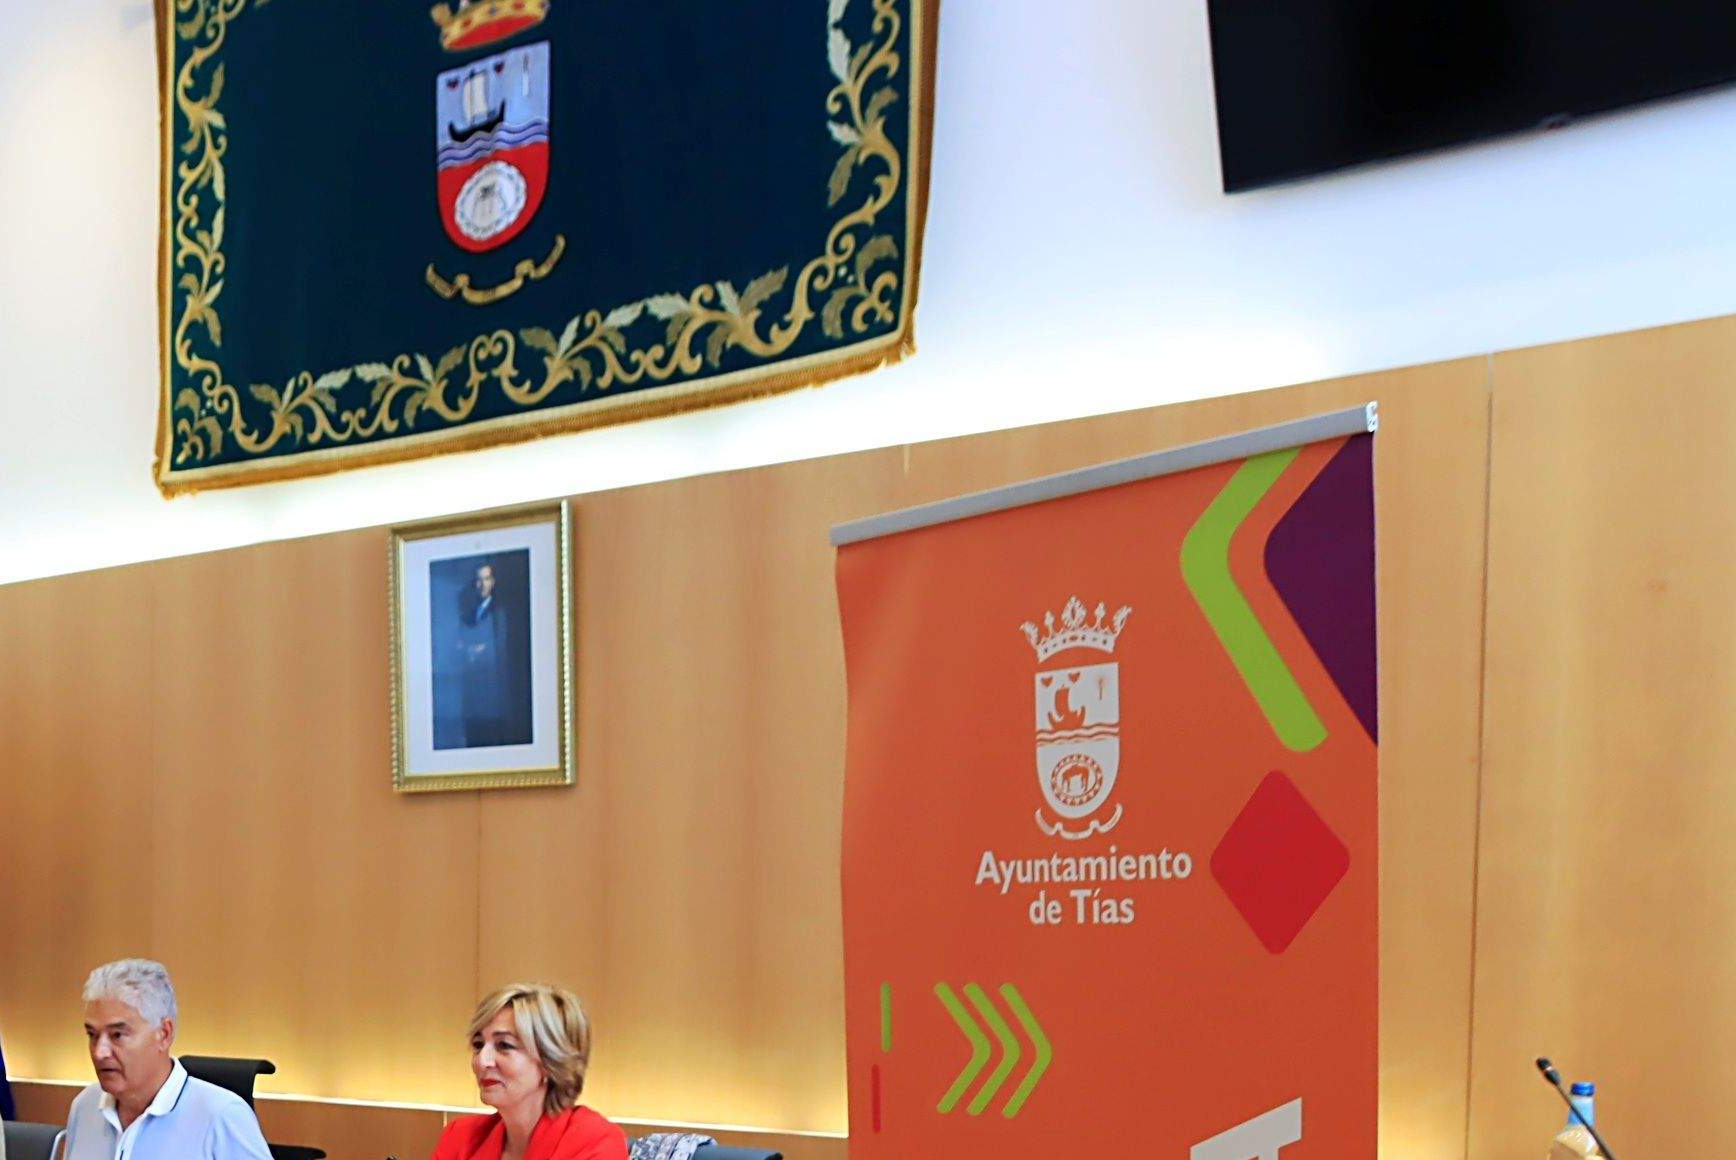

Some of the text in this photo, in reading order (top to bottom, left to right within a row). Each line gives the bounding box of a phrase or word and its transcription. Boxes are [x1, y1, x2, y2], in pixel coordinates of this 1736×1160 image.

[974, 844, 1194, 895] Ayuntamiento
[1028, 887, 1136, 926] de Tías
